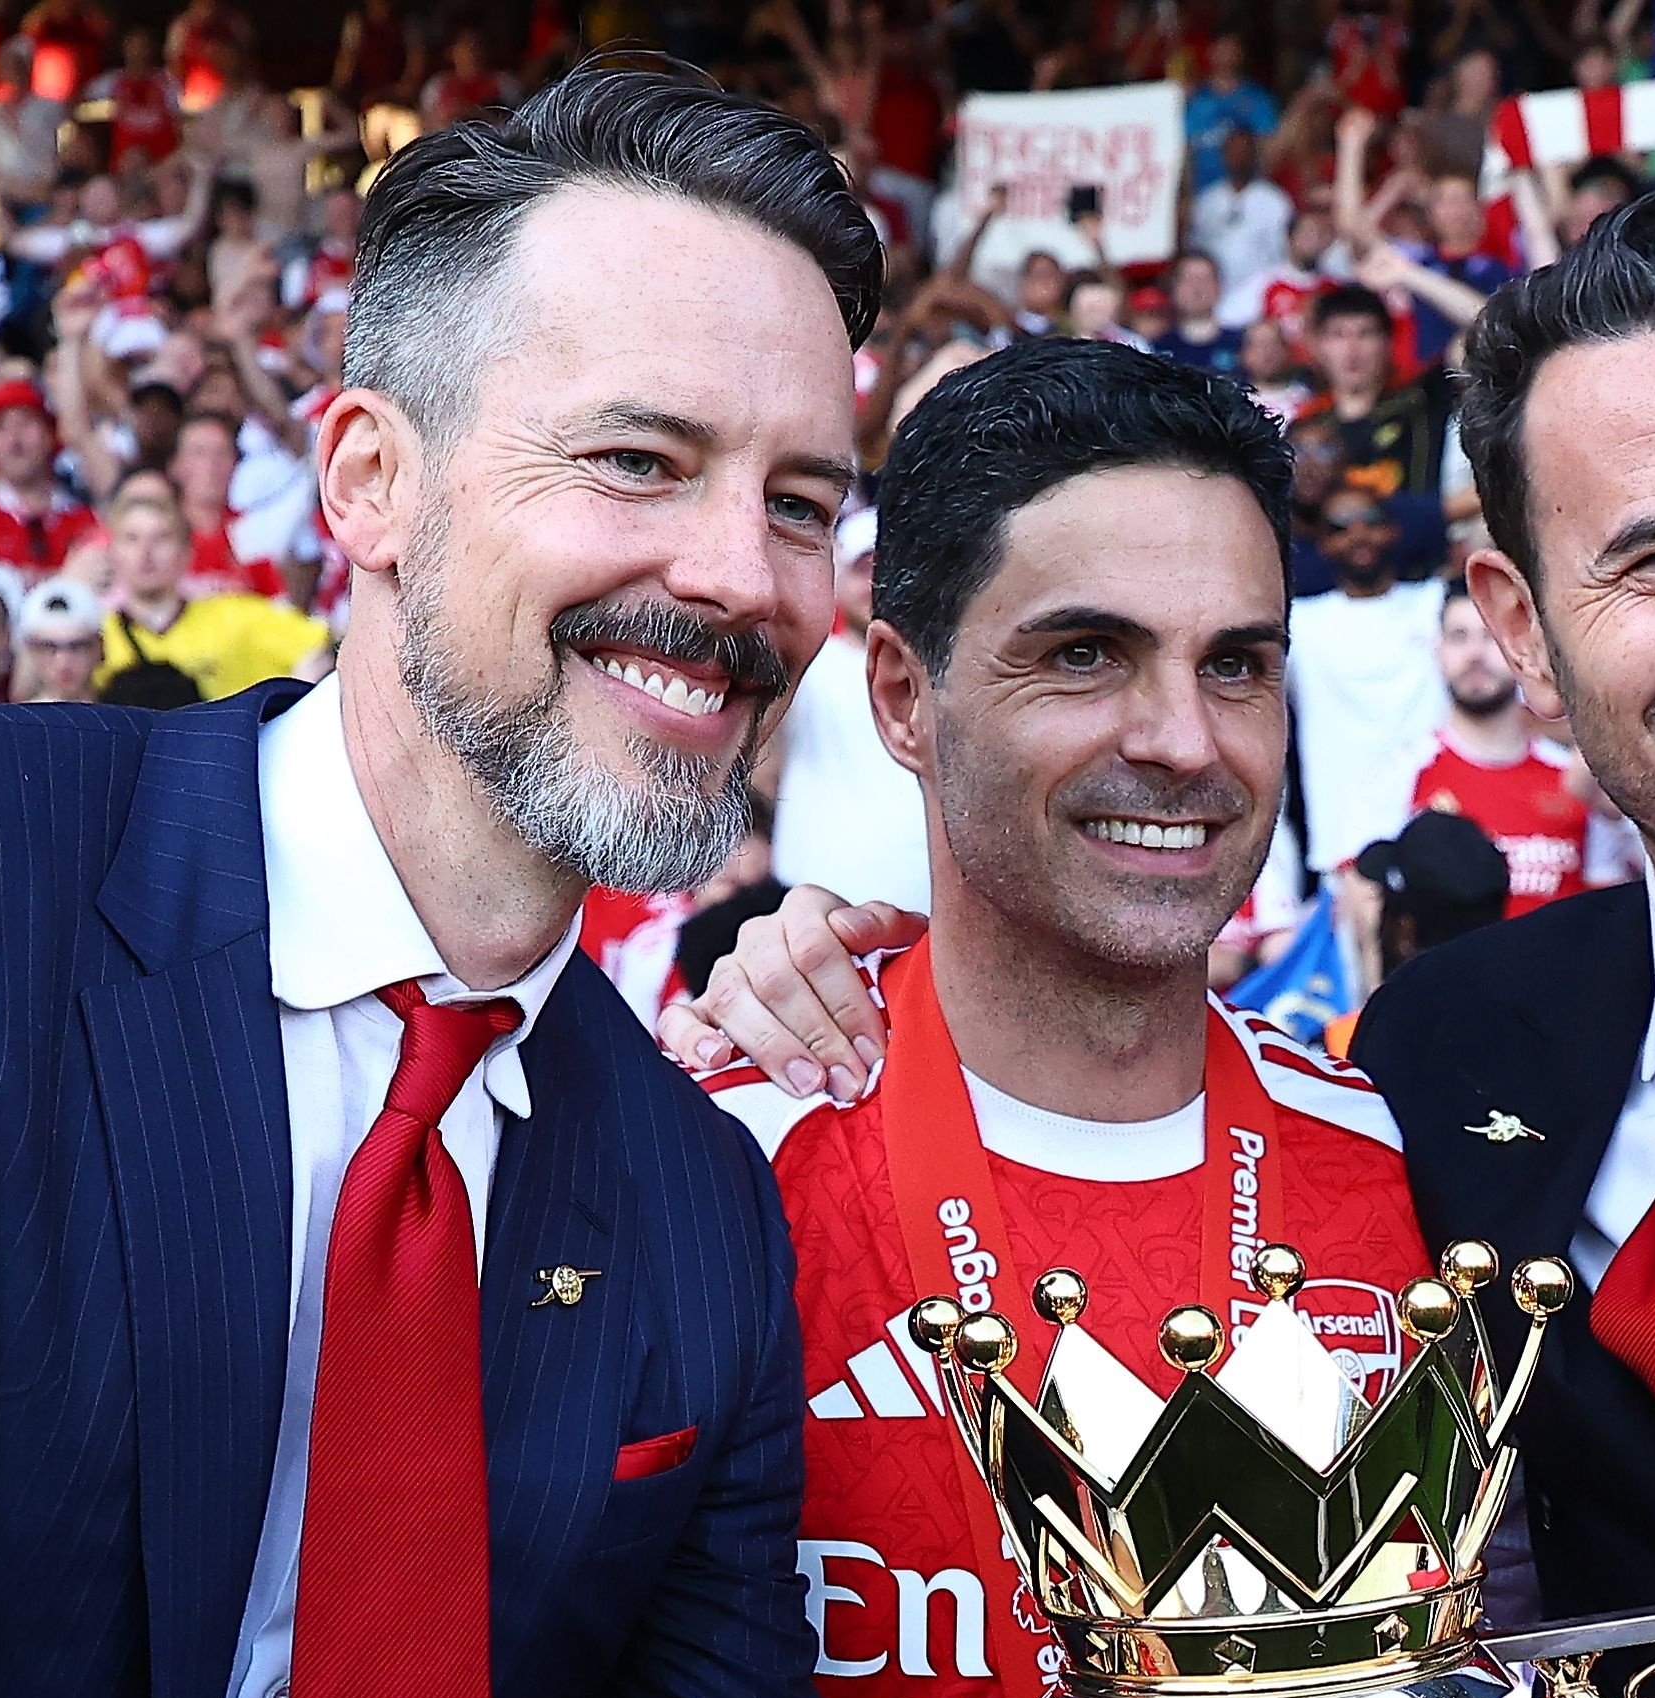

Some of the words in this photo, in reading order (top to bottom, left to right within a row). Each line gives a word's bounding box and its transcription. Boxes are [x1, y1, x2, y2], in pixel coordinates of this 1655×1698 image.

[937, 1198, 998, 1314] ague
[1229, 1126, 1267, 1292] Premier
[1298, 1308, 1384, 1337] Arsenal
